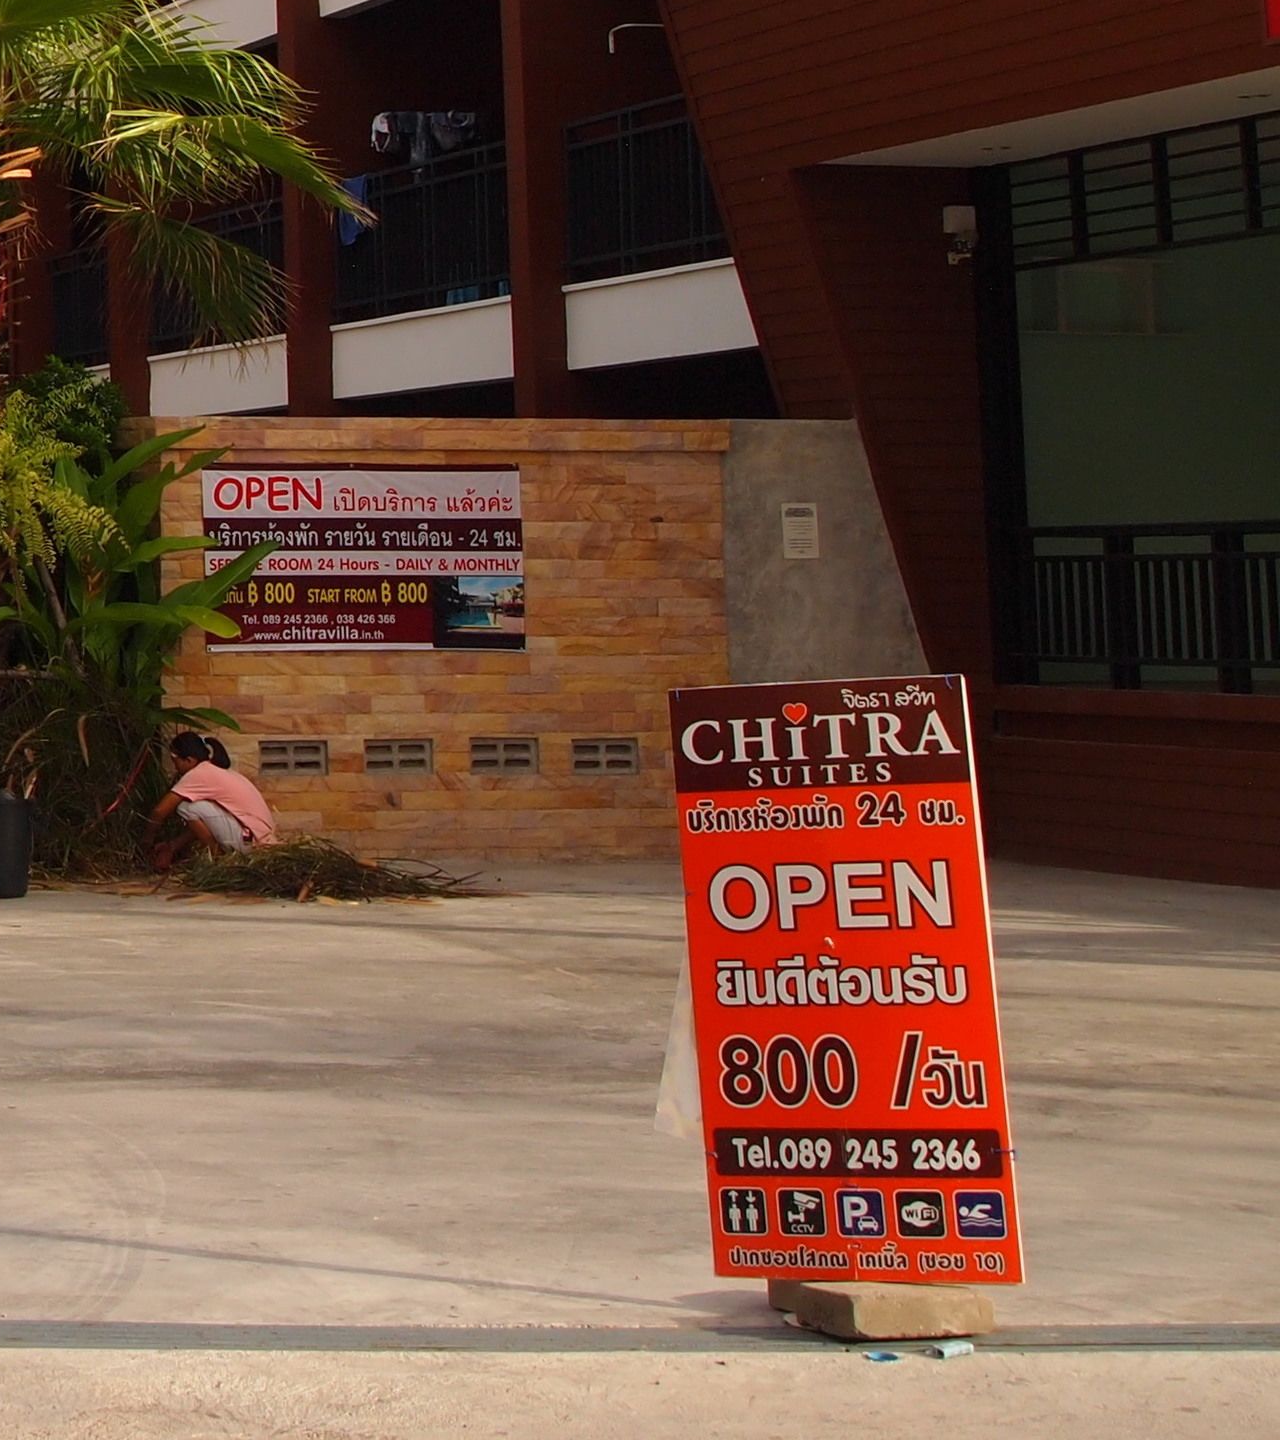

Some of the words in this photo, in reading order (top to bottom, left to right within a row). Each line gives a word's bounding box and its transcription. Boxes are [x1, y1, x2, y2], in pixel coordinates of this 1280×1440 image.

[213, 475, 324, 512] OPEN
[333, 487, 437, 512] เปิดบริการ
[447, 488, 513, 512] แล้วค่ะ
[324, 521, 376, 547] รายวัน
[382, 522, 453, 547] รายเดือน
[469, 529, 489, 547] 24
[493, 529, 521, 547] ชม.
[268, 559, 312, 571] ROOM
[318, 559, 335, 571] 24
[340, 559, 380, 571] Hours
[396, 559, 433, 571] DAILY
[438, 559, 449, 571] &
[453, 559, 521, 571] MONTHLY
[264, 582, 295, 604] 800
[307, 588, 340, 604] START
[344, 588, 377, 603] FROM
[398, 582, 428, 604] 800
[242, 615, 260, 625] Tel.
[262, 615, 281, 625] 089
[283, 615, 302, 625] 245
[304, 615, 329, 625] 2366
[336, 614, 355, 625] 038
[357, 614, 376, 625] 426
[254, 626, 384, 640] www.chitravilla.in.th
[842, 688, 890, 709] จิตรา
[894, 685, 937, 708] สวีท
[748, 762, 892, 788] SUITES
[687, 794, 845, 834] บริการห้องพัก
[856, 792, 907, 828] 24
[917, 799, 966, 827] ชม.
[708, 860, 955, 933] OPEN
[715, 954, 969, 1006] ยินดีต้อนรับ
[718, 1033, 858, 1109] 800
[845, 1138, 897, 1170] 245
[911, 1138, 981, 1171] 2366
[843, 1196, 868, 1228] P
[791, 1223, 815, 1234] CCTV
[729, 1245, 849, 1270] ปากซอยโสภณ
[917, 1252, 966, 1272] (ซอย
[973, 1252, 1005, 1273] 10)
